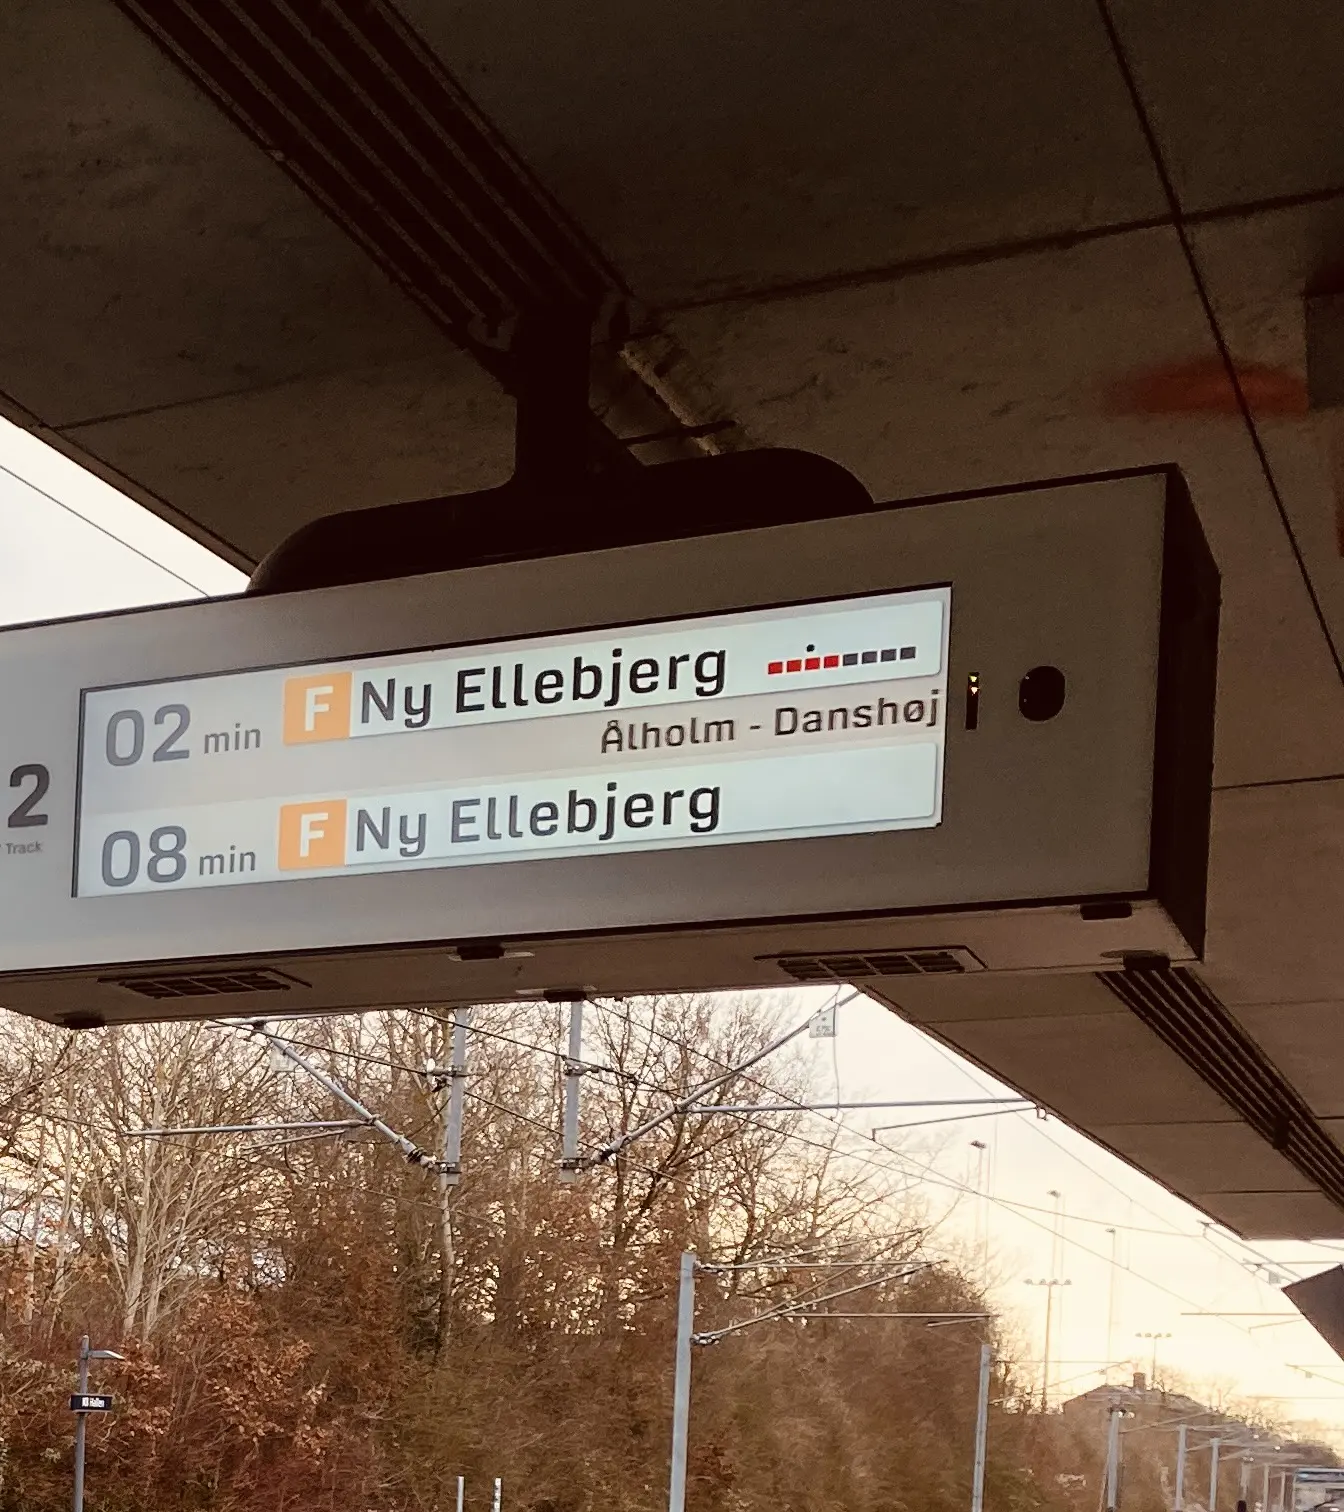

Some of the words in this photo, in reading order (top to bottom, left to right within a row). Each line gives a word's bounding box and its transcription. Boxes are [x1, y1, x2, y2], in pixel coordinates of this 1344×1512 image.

[105, 703, 192, 767] 02
[204, 723, 261, 754] min
[304, 685, 334, 732] F
[360, 678, 432, 728] Ny
[455, 647, 726, 714] Ellebjerg
[600, 715, 735, 754] Ålholm
[774, 689, 941, 737] Danshøj
[5, 841, 43, 855] Track
[101, 825, 187, 887] 08
[198, 844, 256, 876] min
[299, 812, 329, 858] F
[356, 806, 427, 857] Ny
[450, 782, 722, 844] Ellebjerg
